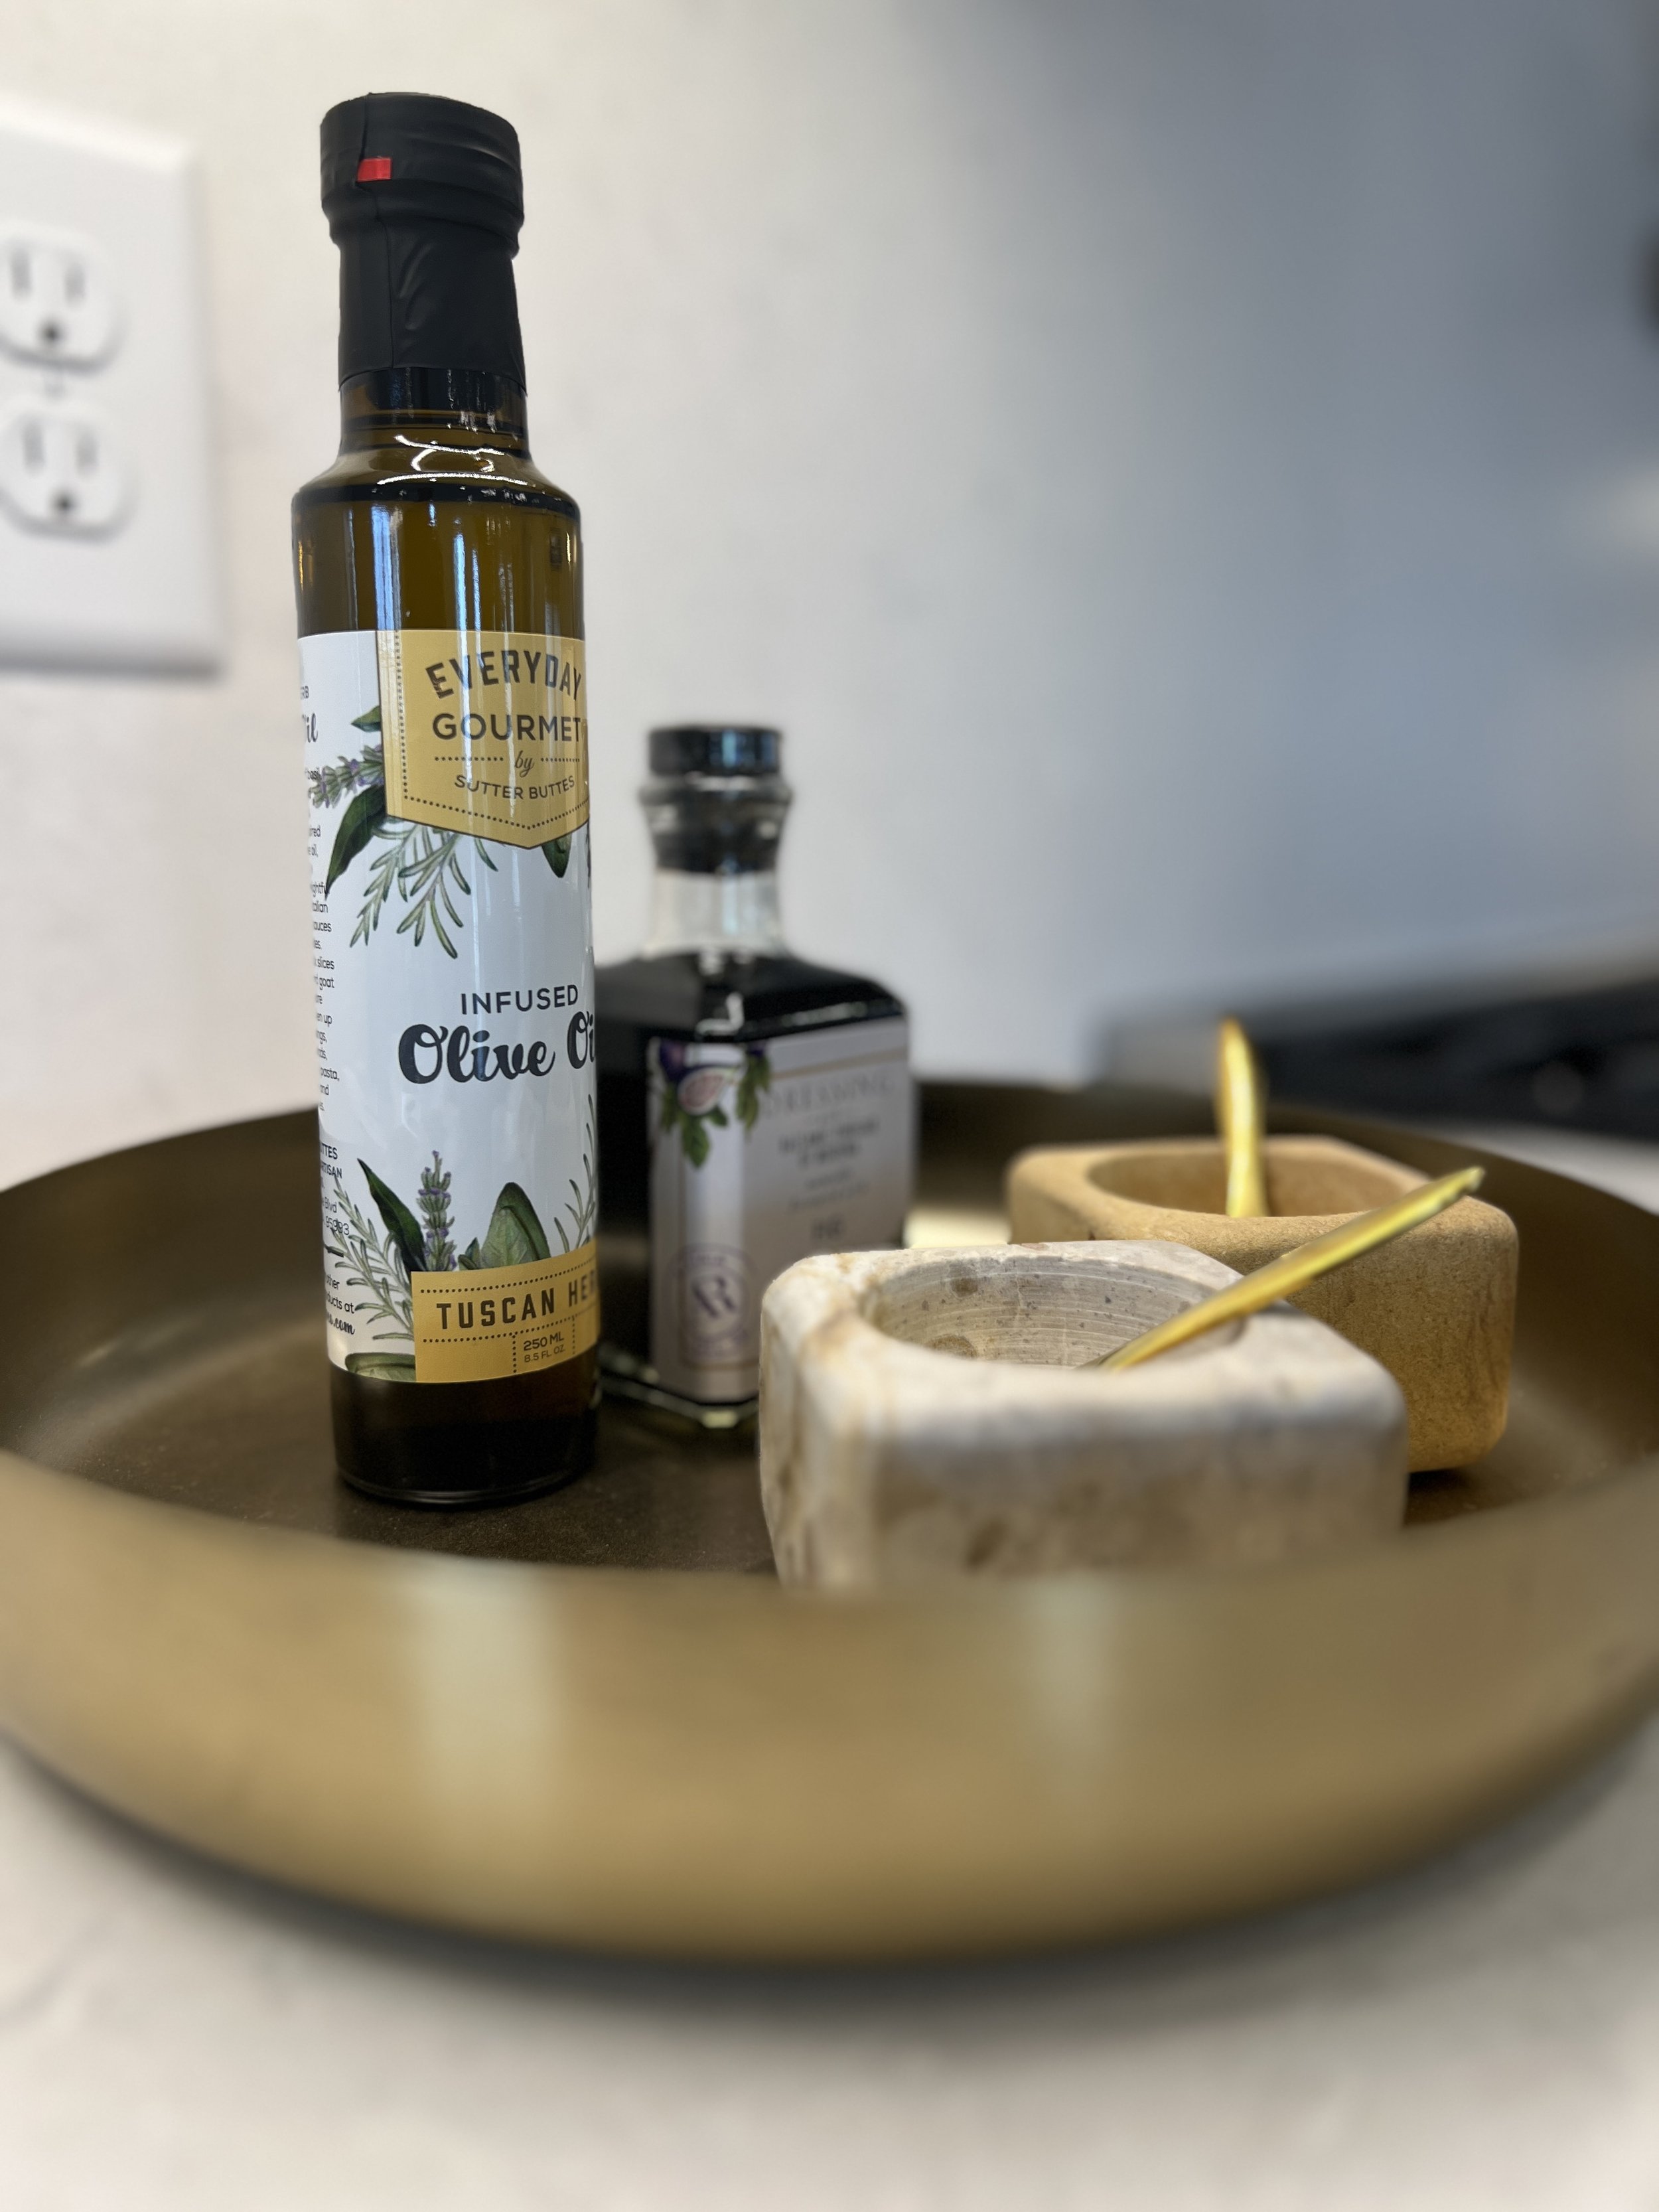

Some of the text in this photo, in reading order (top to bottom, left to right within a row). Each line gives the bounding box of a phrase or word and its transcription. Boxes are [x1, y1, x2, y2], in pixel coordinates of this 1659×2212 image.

[425, 650, 582, 701] EVERYDAY
[433, 713, 581, 743] GOURMET
[515, 751, 535, 778] by
[455, 775, 575, 800] SUTTER BUTTES
[319, 977, 334, 991] goat
[461, 984, 579, 1015] INFUSED
[324, 1015, 332, 1027] up
[398, 1023, 556, 1084] Olive
[344, 1302, 355, 1314] at
[436, 1288, 555, 1330] TUSCAN
[523, 1331, 565, 1351] 250 ML
